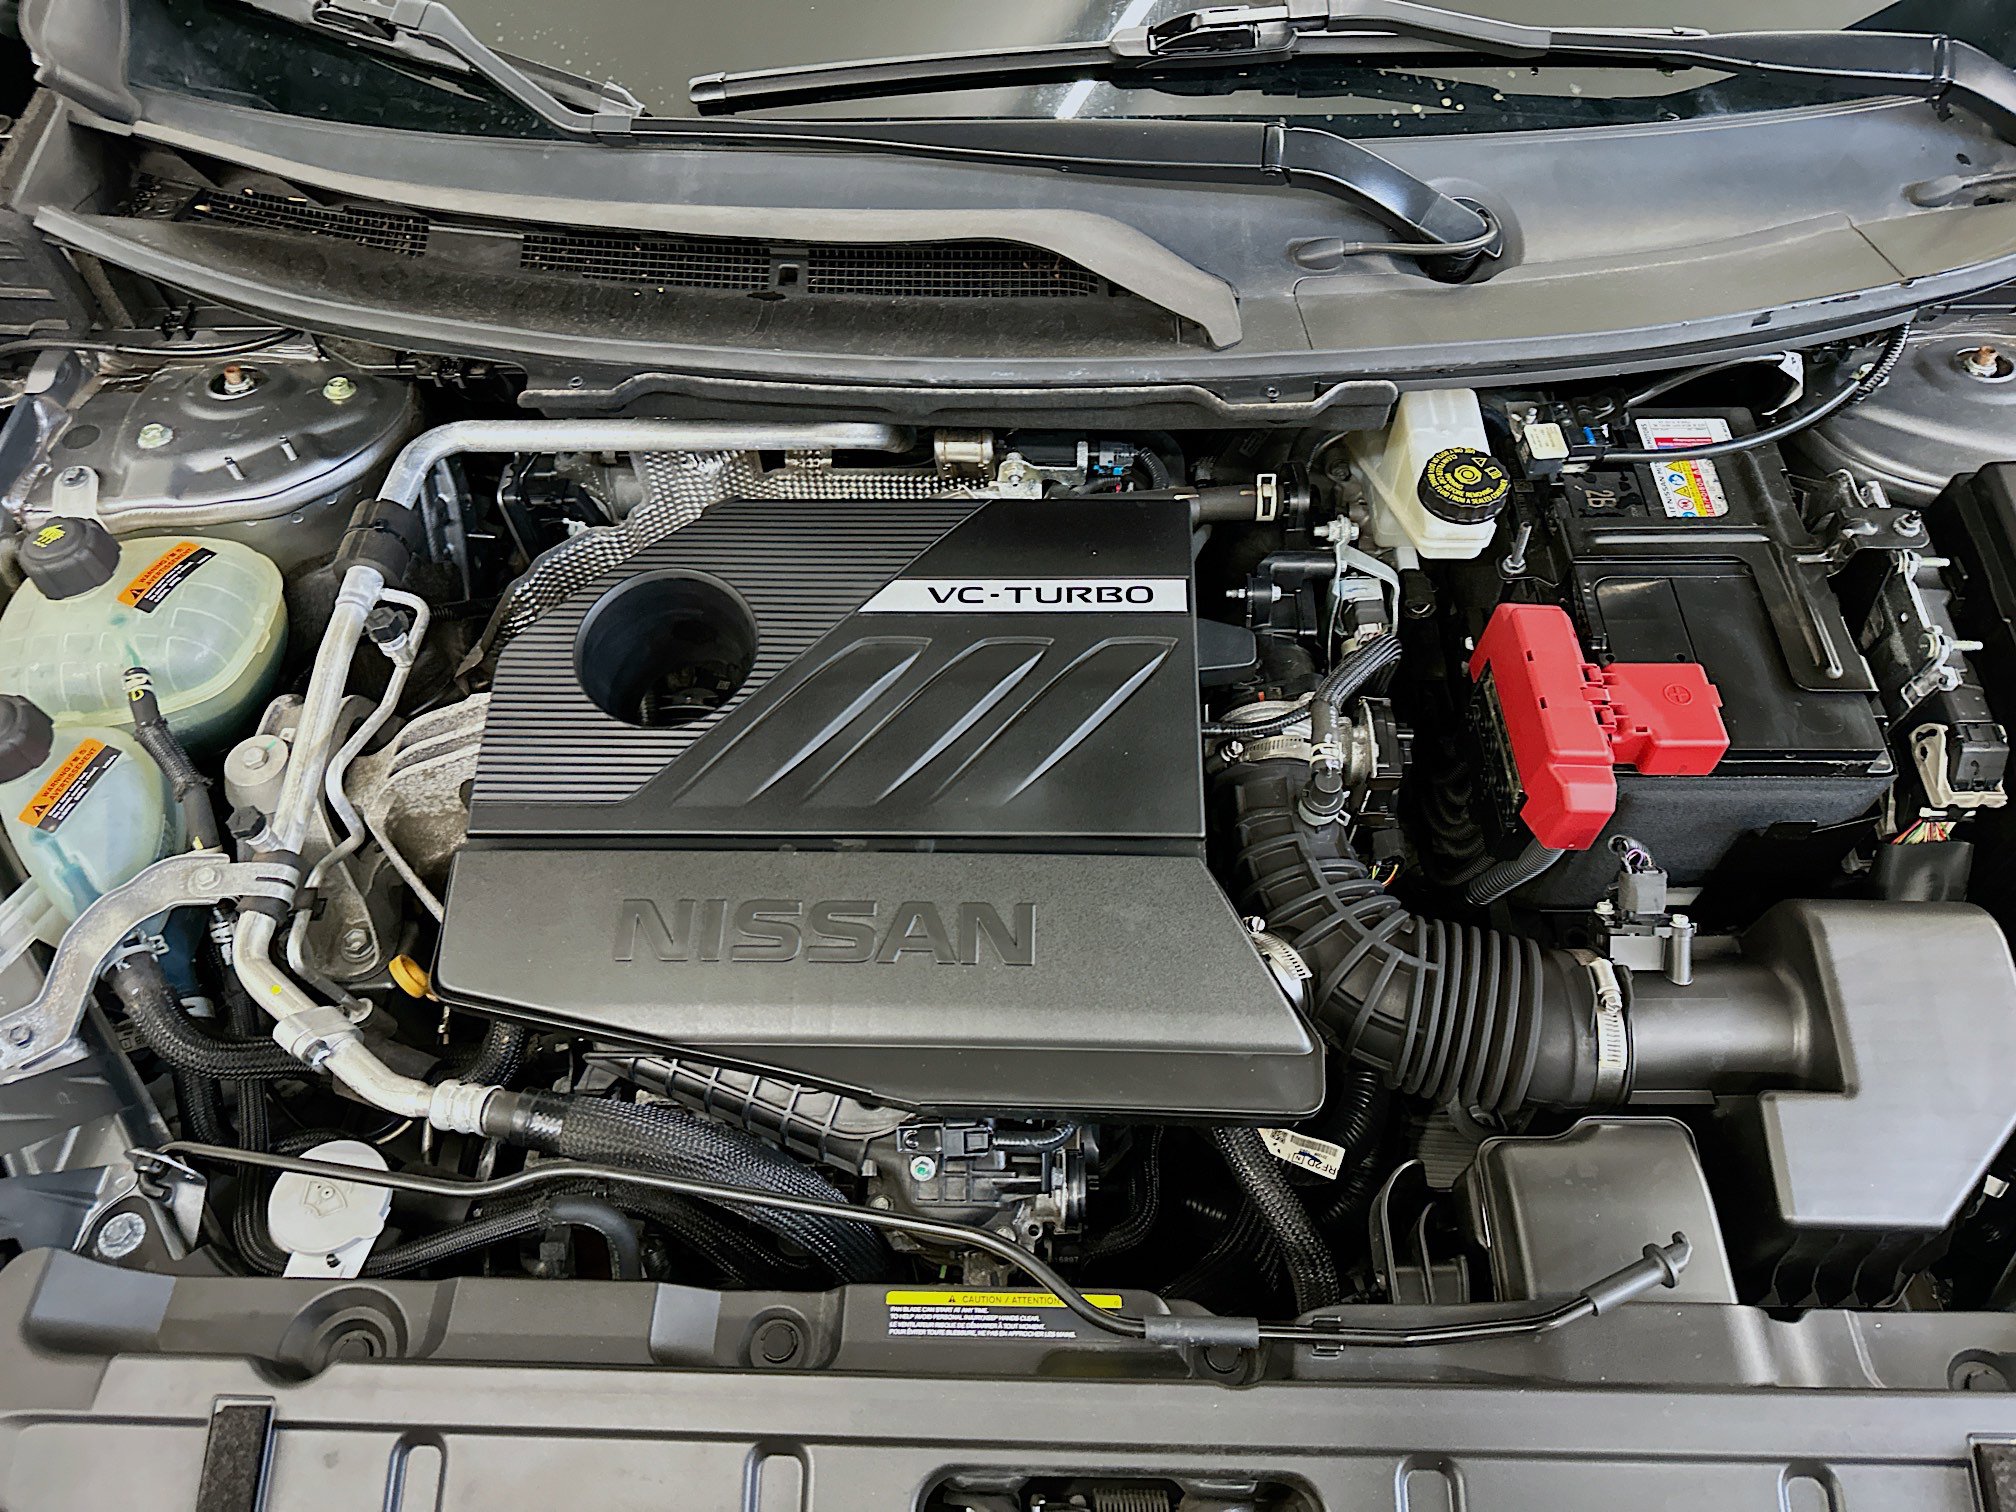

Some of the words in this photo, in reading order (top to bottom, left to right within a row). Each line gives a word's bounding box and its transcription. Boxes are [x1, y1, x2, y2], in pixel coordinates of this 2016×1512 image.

[1449, 494, 1465, 503] FROM
[927, 585, 1154, 604] VC-TURBO
[42, 766, 71, 798] WARNING
[49, 746, 97, 801] AVERTISSEMENT
[613, 898, 1037, 966] NISSAN
[1307, 1159, 1338, 1175] RF2D
[1012, 1296, 1060, 1305] ATTENTION
[888, 1328, 906, 1336] POUR
